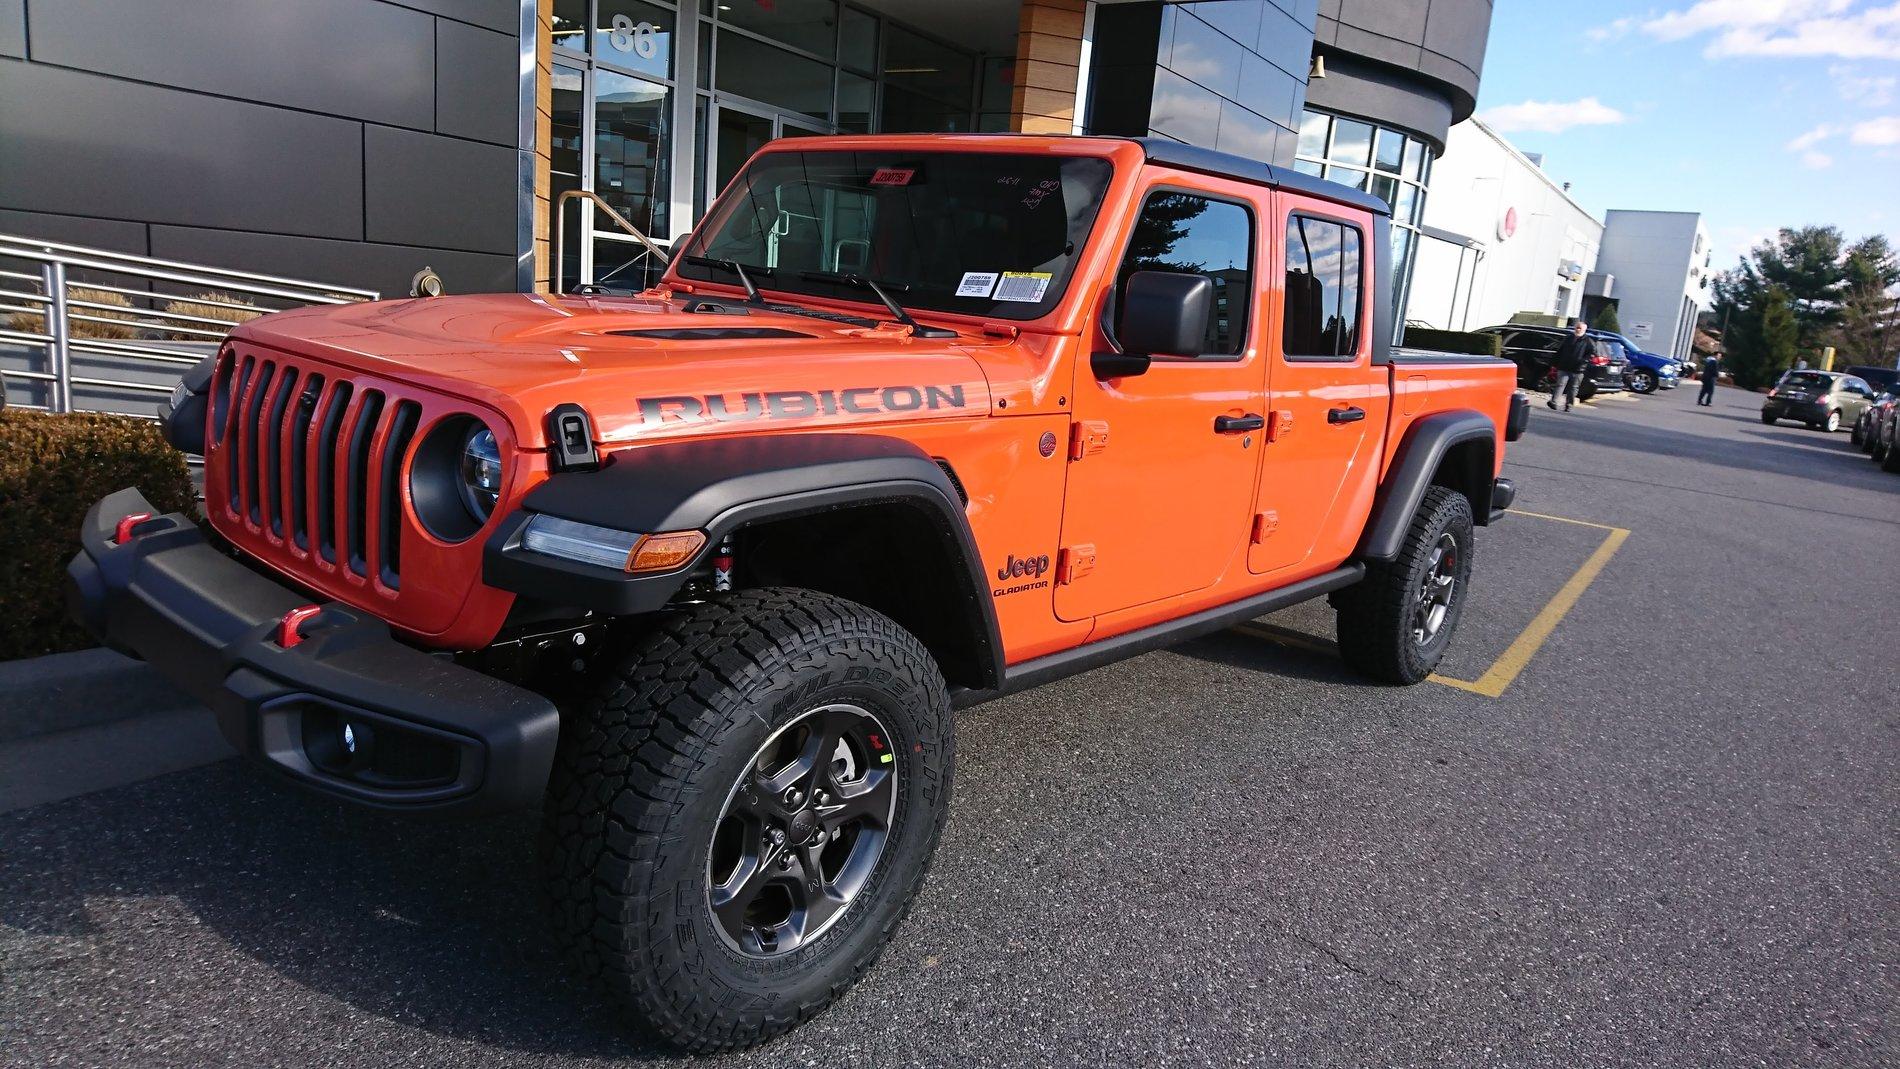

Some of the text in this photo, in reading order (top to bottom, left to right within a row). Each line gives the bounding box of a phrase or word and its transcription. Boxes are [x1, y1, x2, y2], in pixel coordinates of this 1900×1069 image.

[610, 13, 657, 60] 86
[635, 384, 967, 425] RUBICON
[997, 554, 1050, 581] Jeep
[993, 580, 1049, 598] GLADIATOR
